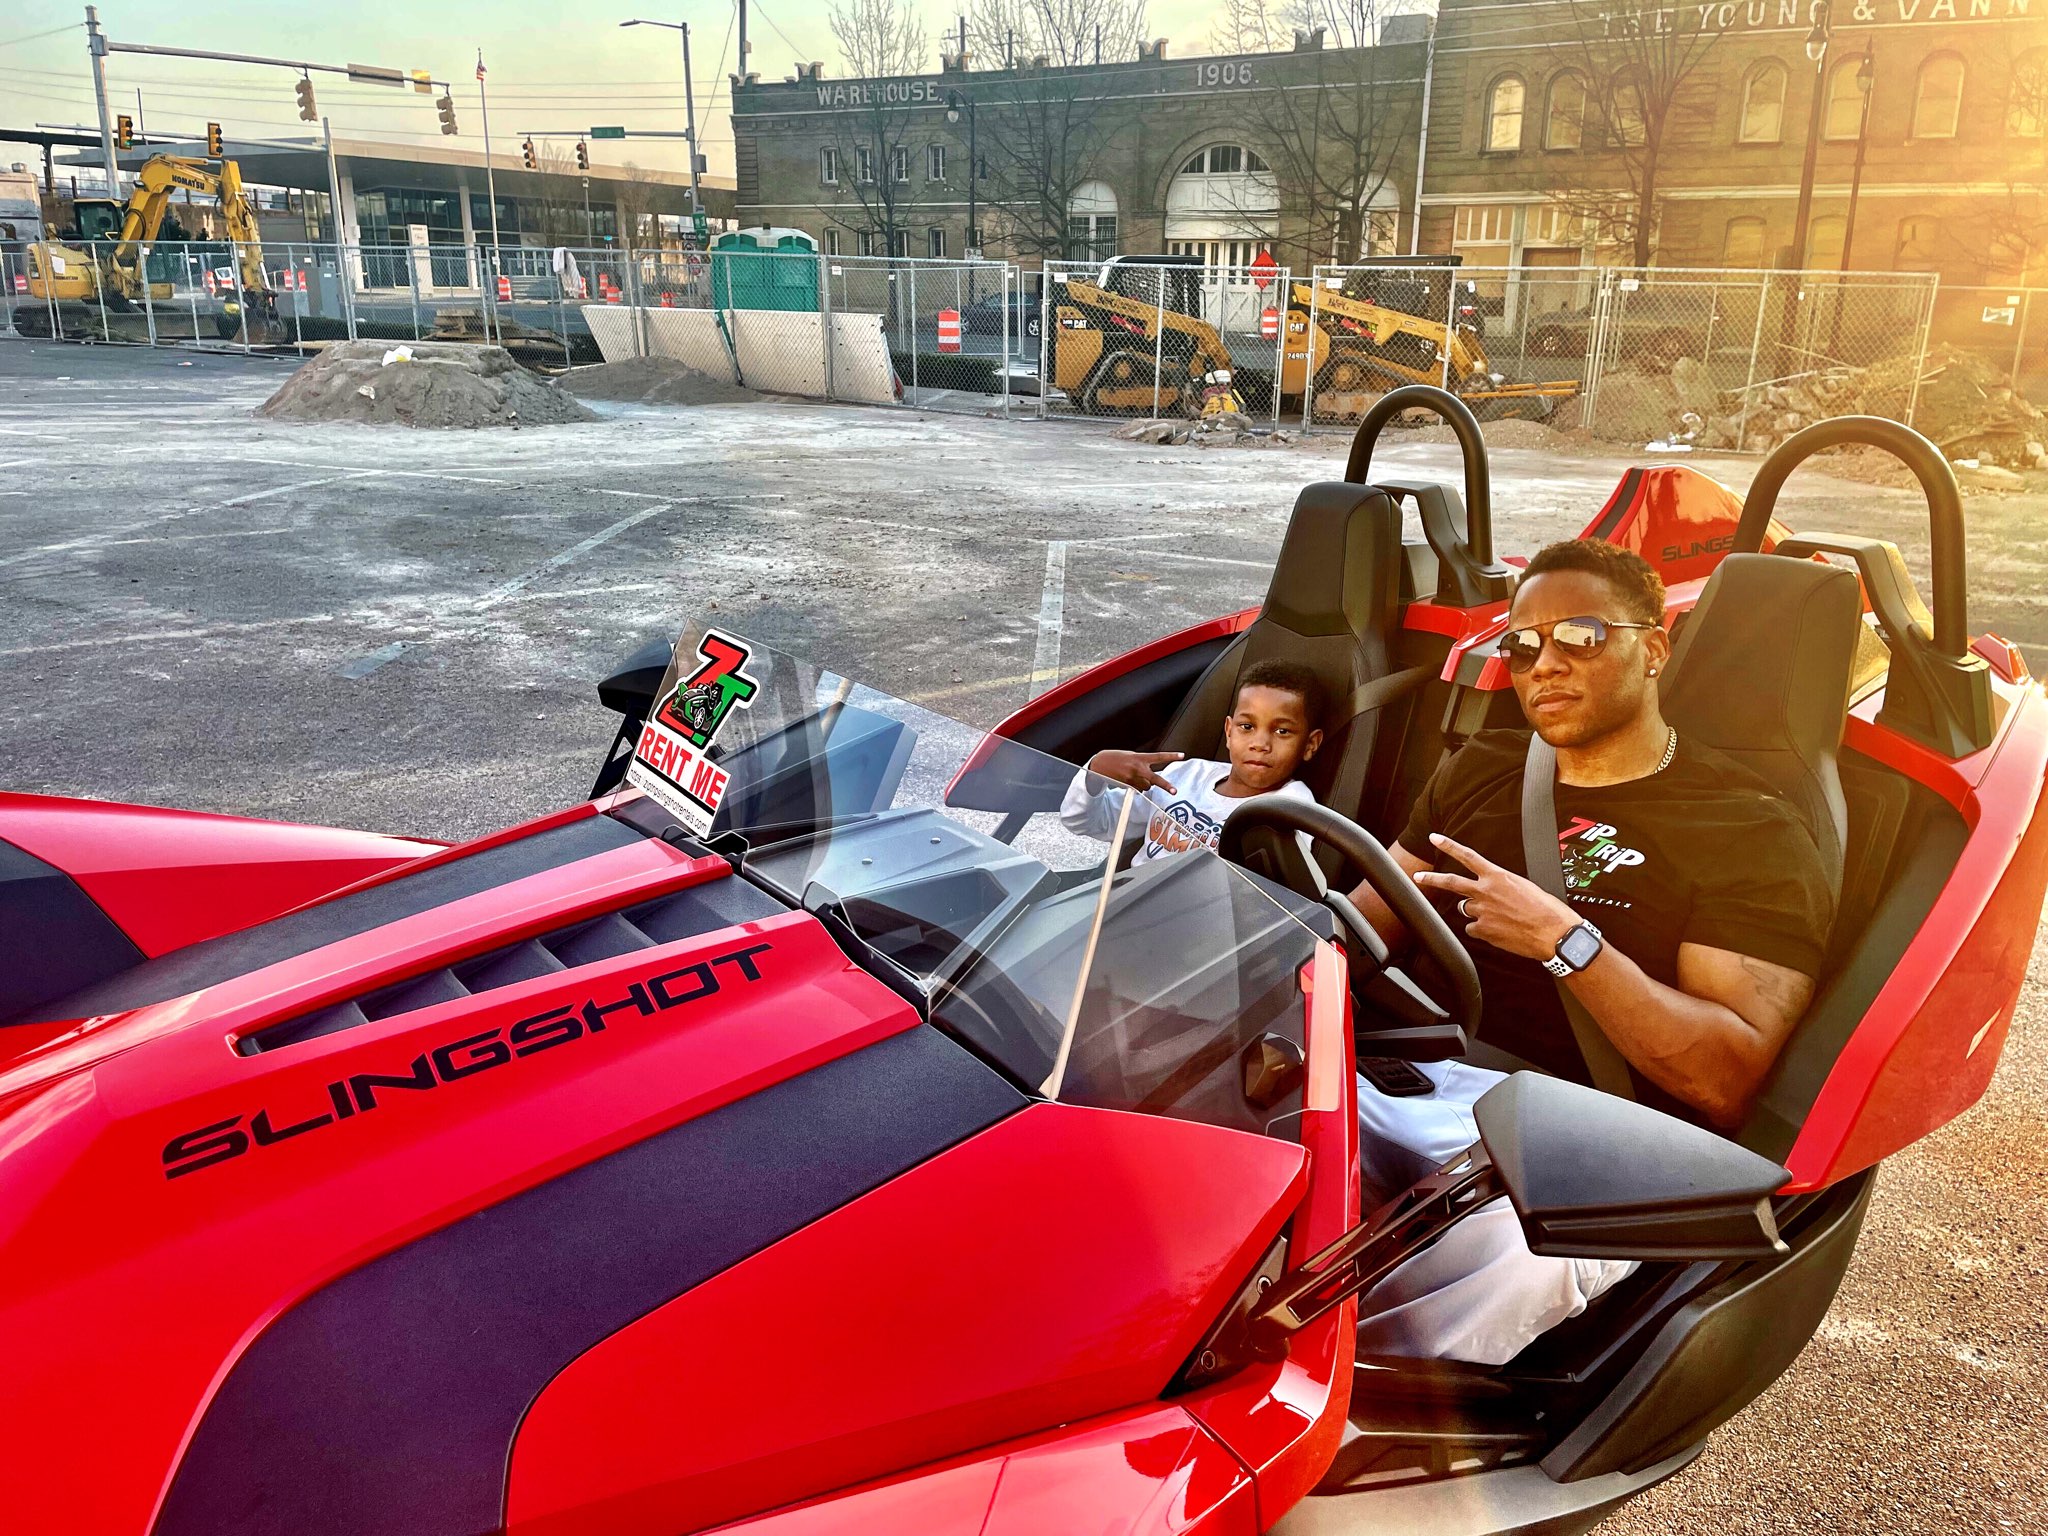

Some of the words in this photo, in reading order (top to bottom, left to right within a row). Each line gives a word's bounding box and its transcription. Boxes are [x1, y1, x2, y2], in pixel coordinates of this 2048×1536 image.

[1853, 0, 1876, 20] &
[1196, 62, 1260, 87] 1906.
[171, 174, 205, 190] KOMATSU
[1073, 319, 1087, 329] CAT
[1289, 322, 1305, 333] CAT
[1662, 533, 1736, 562] SLINGS
[637, 725, 693, 783] RENT
[689, 756, 728, 810] ME
[162, 942, 775, 1181] SLINGSHOT
